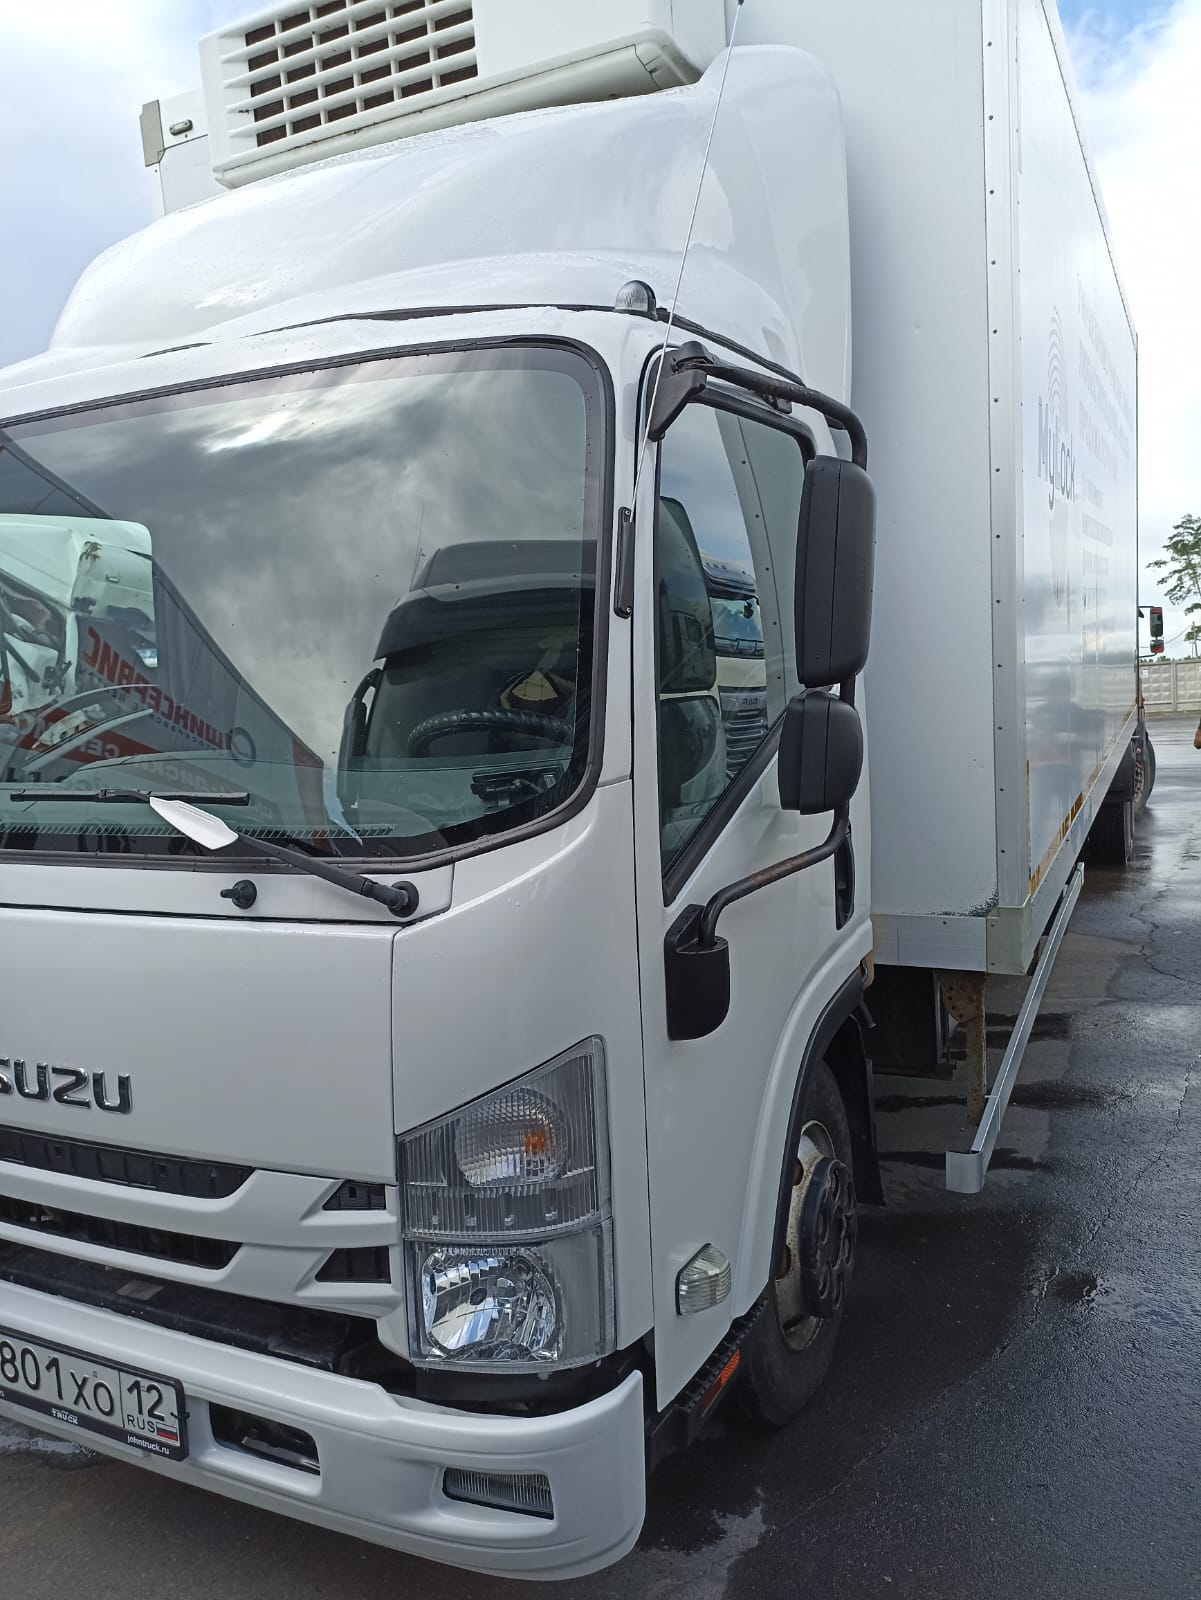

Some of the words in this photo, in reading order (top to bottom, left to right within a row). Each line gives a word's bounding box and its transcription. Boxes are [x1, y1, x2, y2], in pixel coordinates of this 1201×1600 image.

[1038, 395, 1075, 510] MyLock
[127, 1378, 166, 1422] 12
[52, 1409, 79, 1425] TRUCK
[127, 1414, 155, 1434] RUS
[127, 1434, 170, 1455] johntruck.ru
